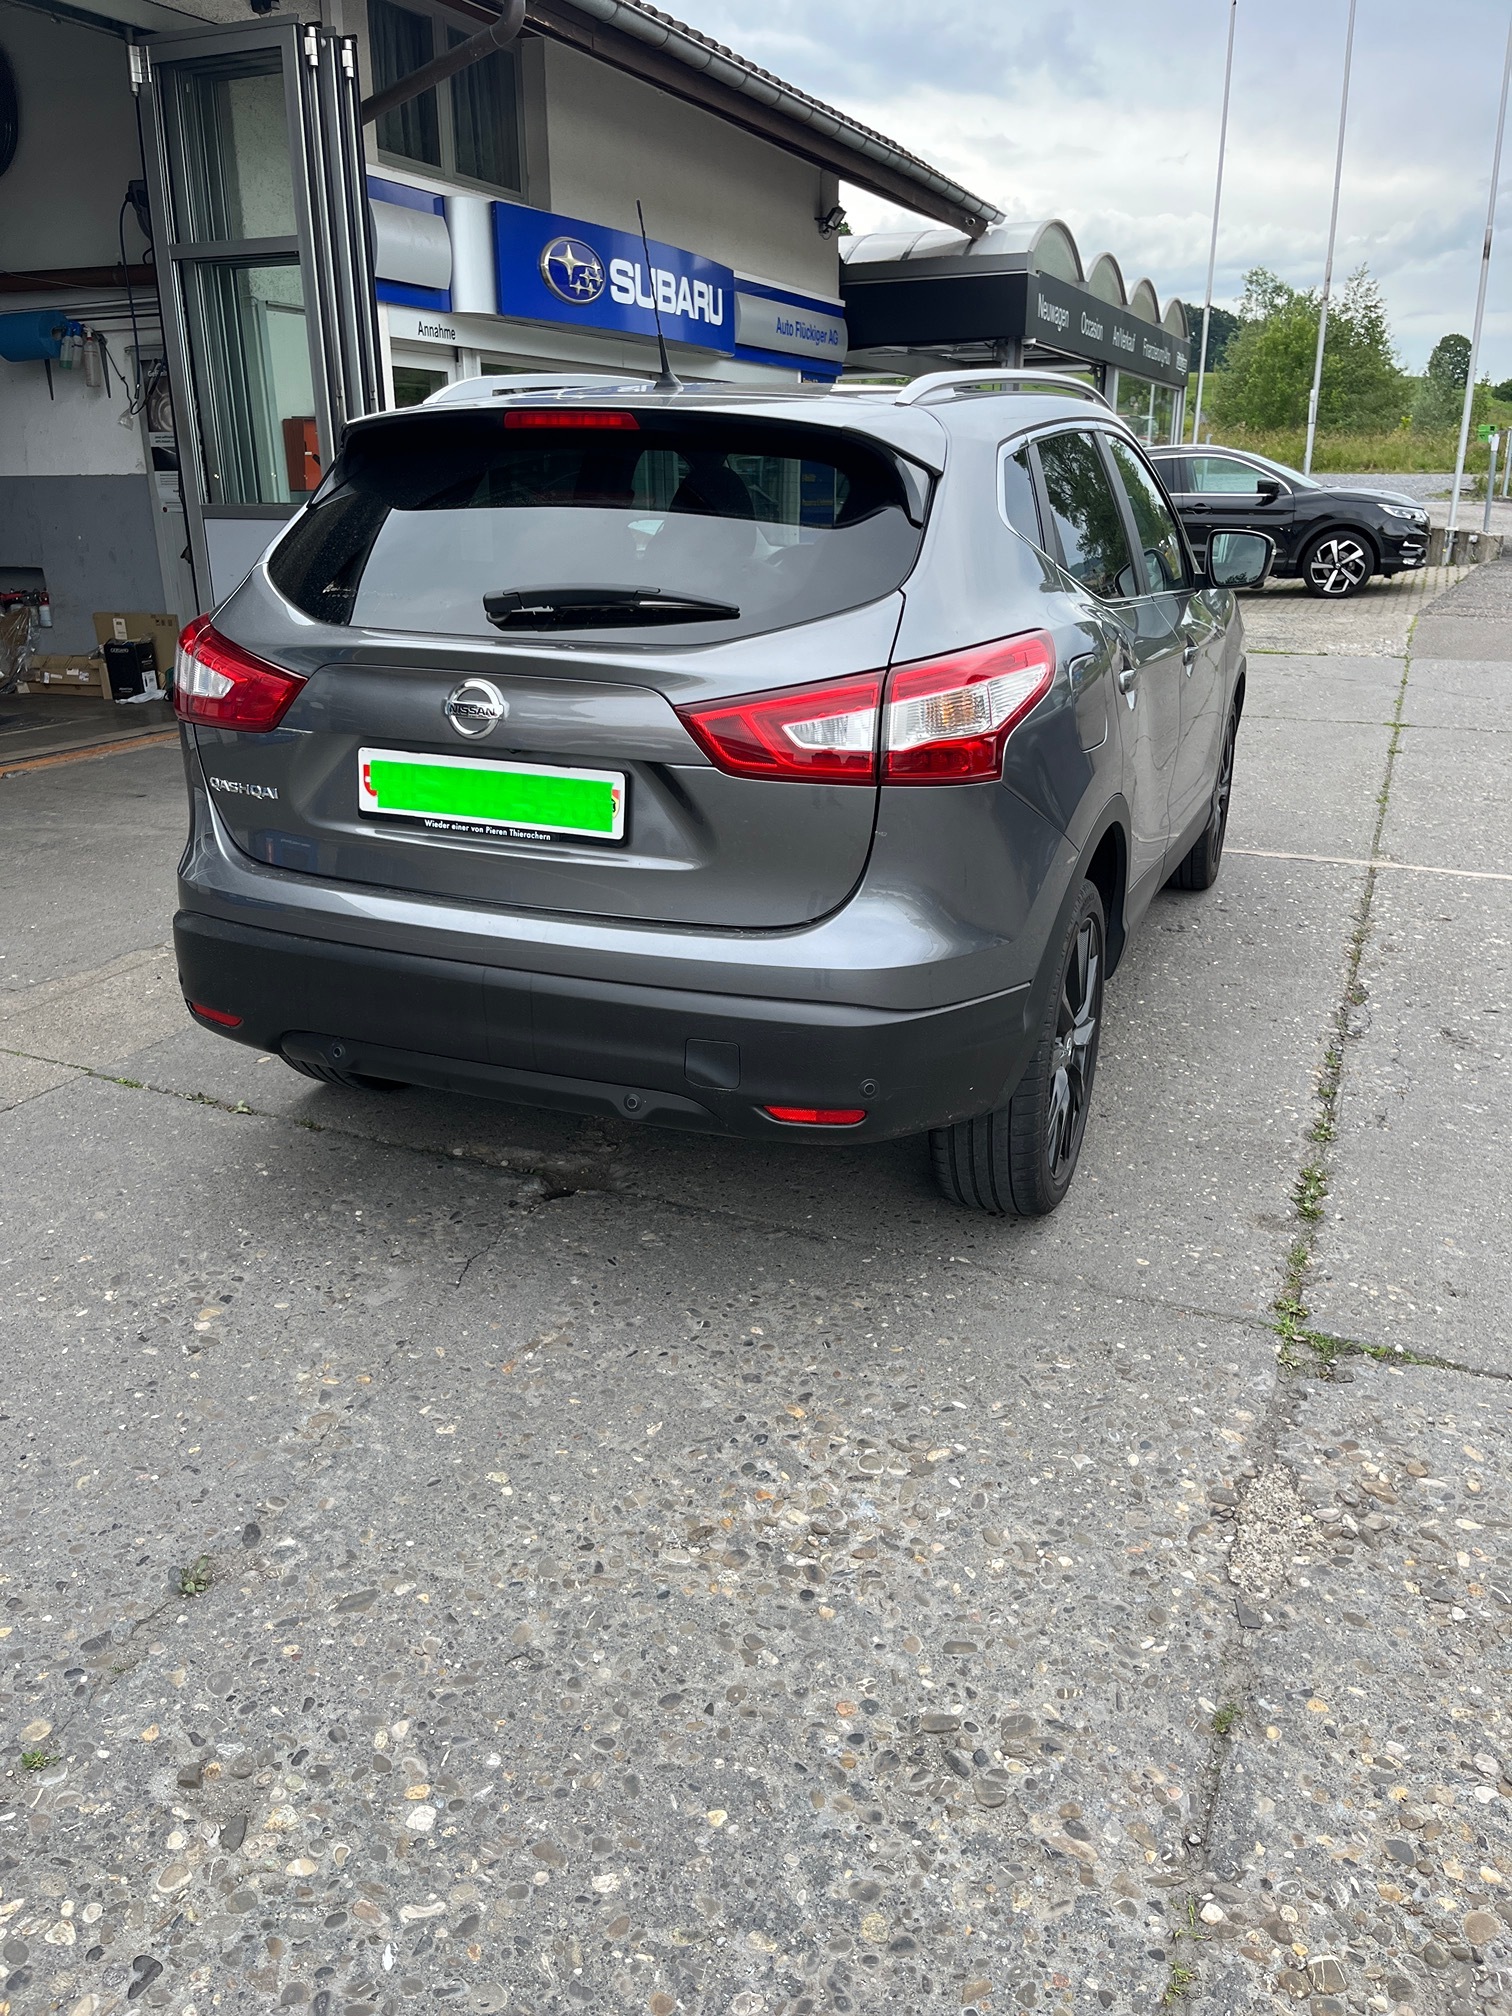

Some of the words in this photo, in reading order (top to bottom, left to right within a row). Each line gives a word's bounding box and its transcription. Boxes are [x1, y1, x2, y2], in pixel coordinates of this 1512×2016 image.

[609, 258, 723, 326] SUBARU
[1038, 293, 1070, 332] Neuwagen
[1081, 311, 1104, 341] Occasion
[418, 321, 456, 340] Annahme
[776, 317, 794, 336] Auto
[795, 321, 828, 346] Flückiger
[828, 329, 839, 346] AG
[450, 704, 496, 716] NISSAN
[209, 777, 279, 800] QASHQAI
[424, 819, 450, 830] Wieder
[451, 823, 470, 832] einer
[485, 826, 508, 836] Pieren
[509, 829, 551, 841] Thierachern
